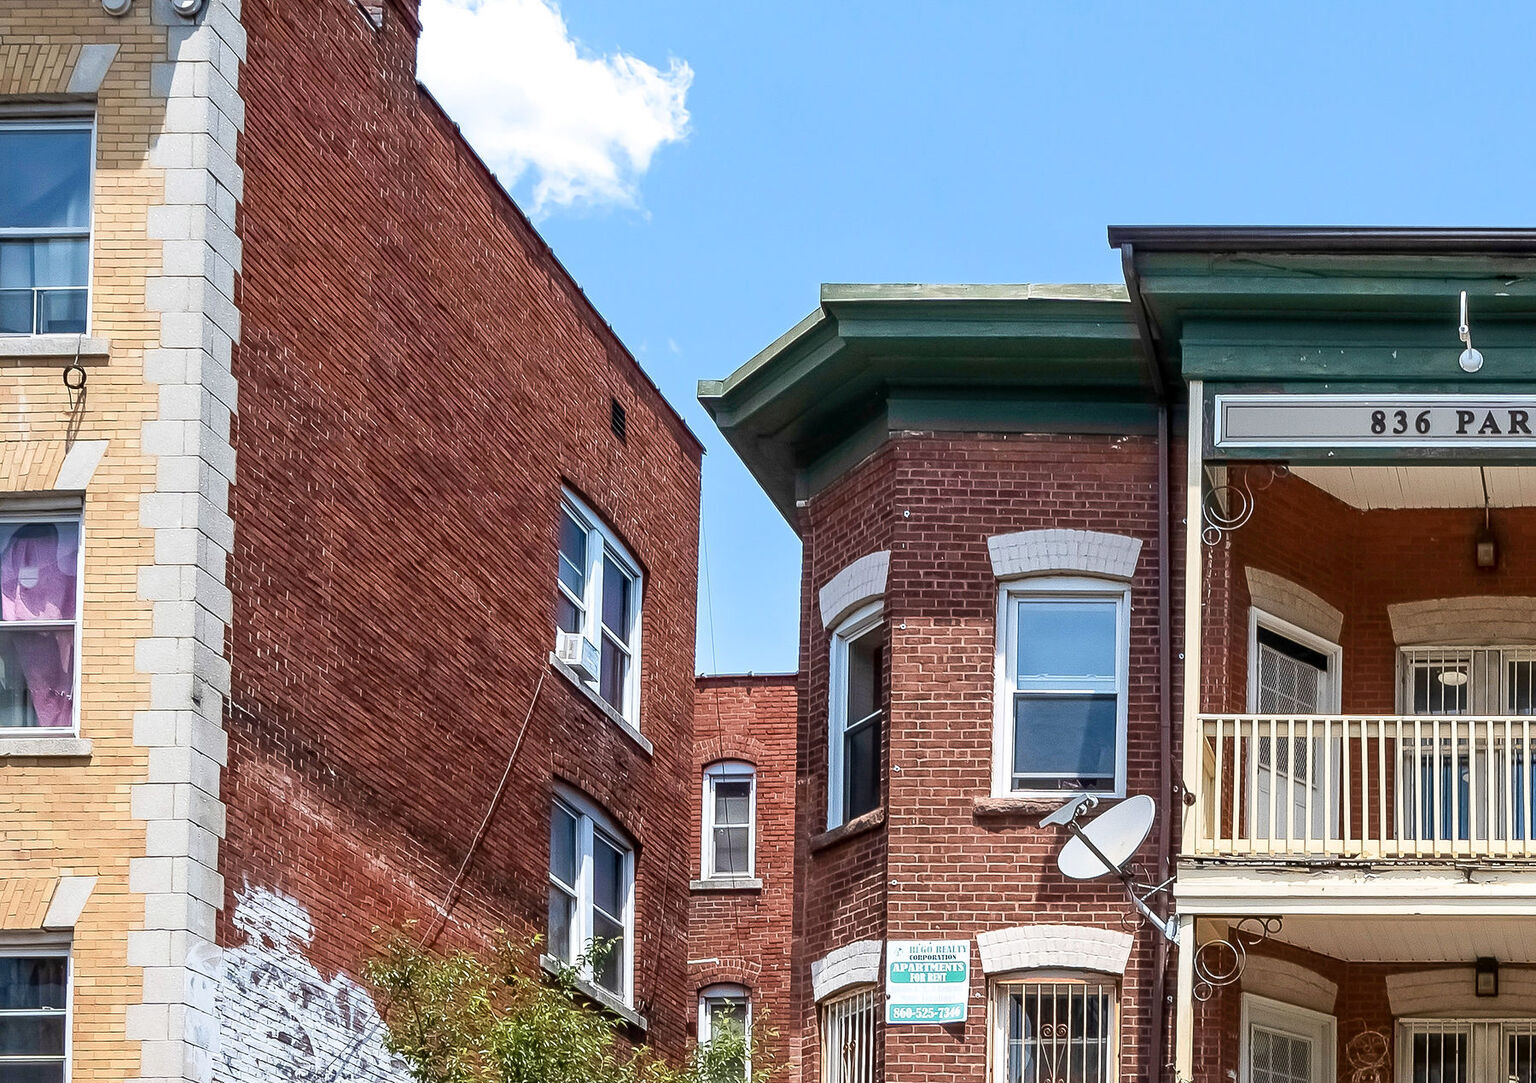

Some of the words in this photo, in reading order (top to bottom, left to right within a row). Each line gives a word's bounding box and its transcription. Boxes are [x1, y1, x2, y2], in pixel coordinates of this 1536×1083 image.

[1370, 409, 1431, 435] 836
[935, 944, 968, 954] REALTY
[892, 962, 965, 972] APARTMENTS
[909, 972, 926, 982] FOR
[927, 972, 948, 982] RENT
